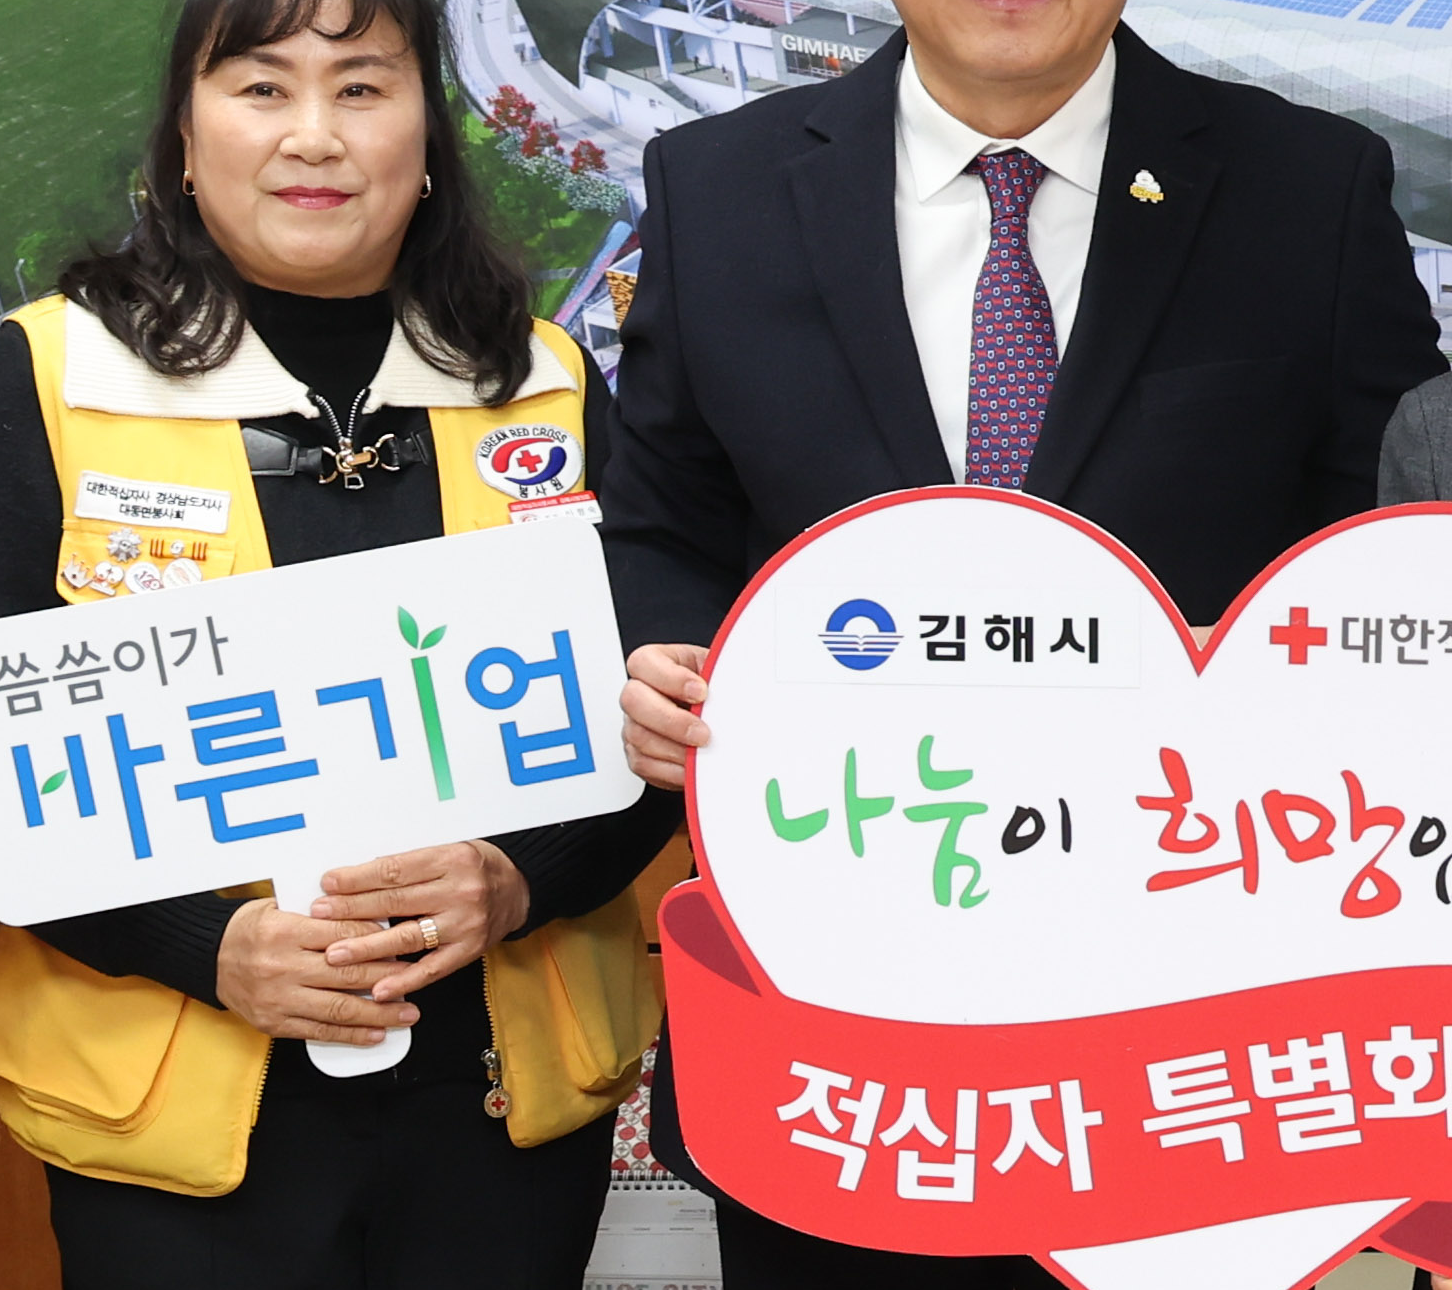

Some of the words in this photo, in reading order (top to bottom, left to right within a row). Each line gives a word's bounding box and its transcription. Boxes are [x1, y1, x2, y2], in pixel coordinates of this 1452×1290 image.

[780, 33, 866, 65] GIMHAE
[479, 429, 510, 459] KOREAN
[509, 428, 529, 438] RED
[533, 428, 567, 444] CROSS
[86, 481, 150, 501] 대한적십자사
[156, 491, 222, 512] 경상남도지사
[918, 612, 1100, 665] 김해시
[11, 606, 596, 860] 바른기업
[764, 734, 1072, 908] 나눔이
[775, 1059, 1102, 1203] 적십자
